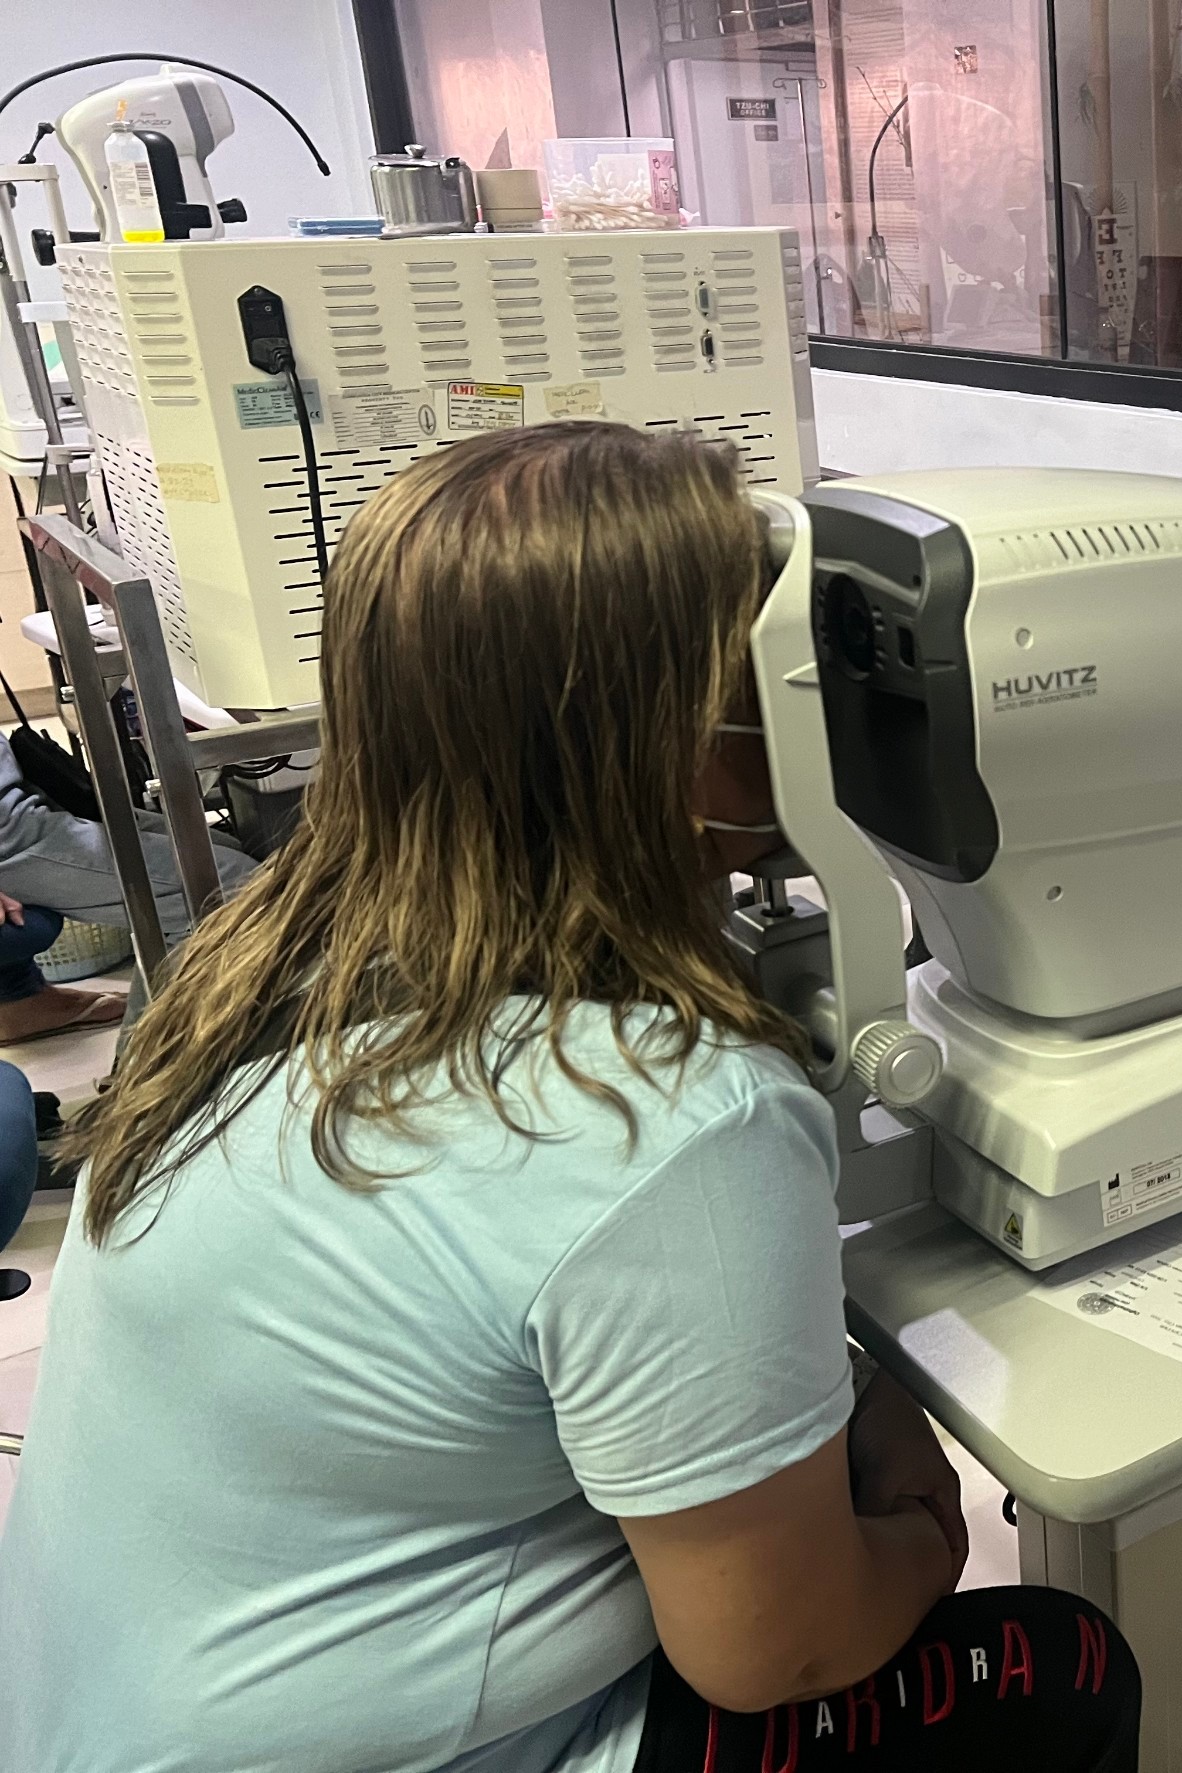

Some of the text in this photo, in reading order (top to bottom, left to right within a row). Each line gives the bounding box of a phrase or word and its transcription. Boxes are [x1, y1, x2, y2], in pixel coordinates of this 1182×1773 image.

[736, 102, 769, 110] TZU-CHI
[450, 384, 475, 395] AMI
[992, 664, 1098, 699] HUVITZ
